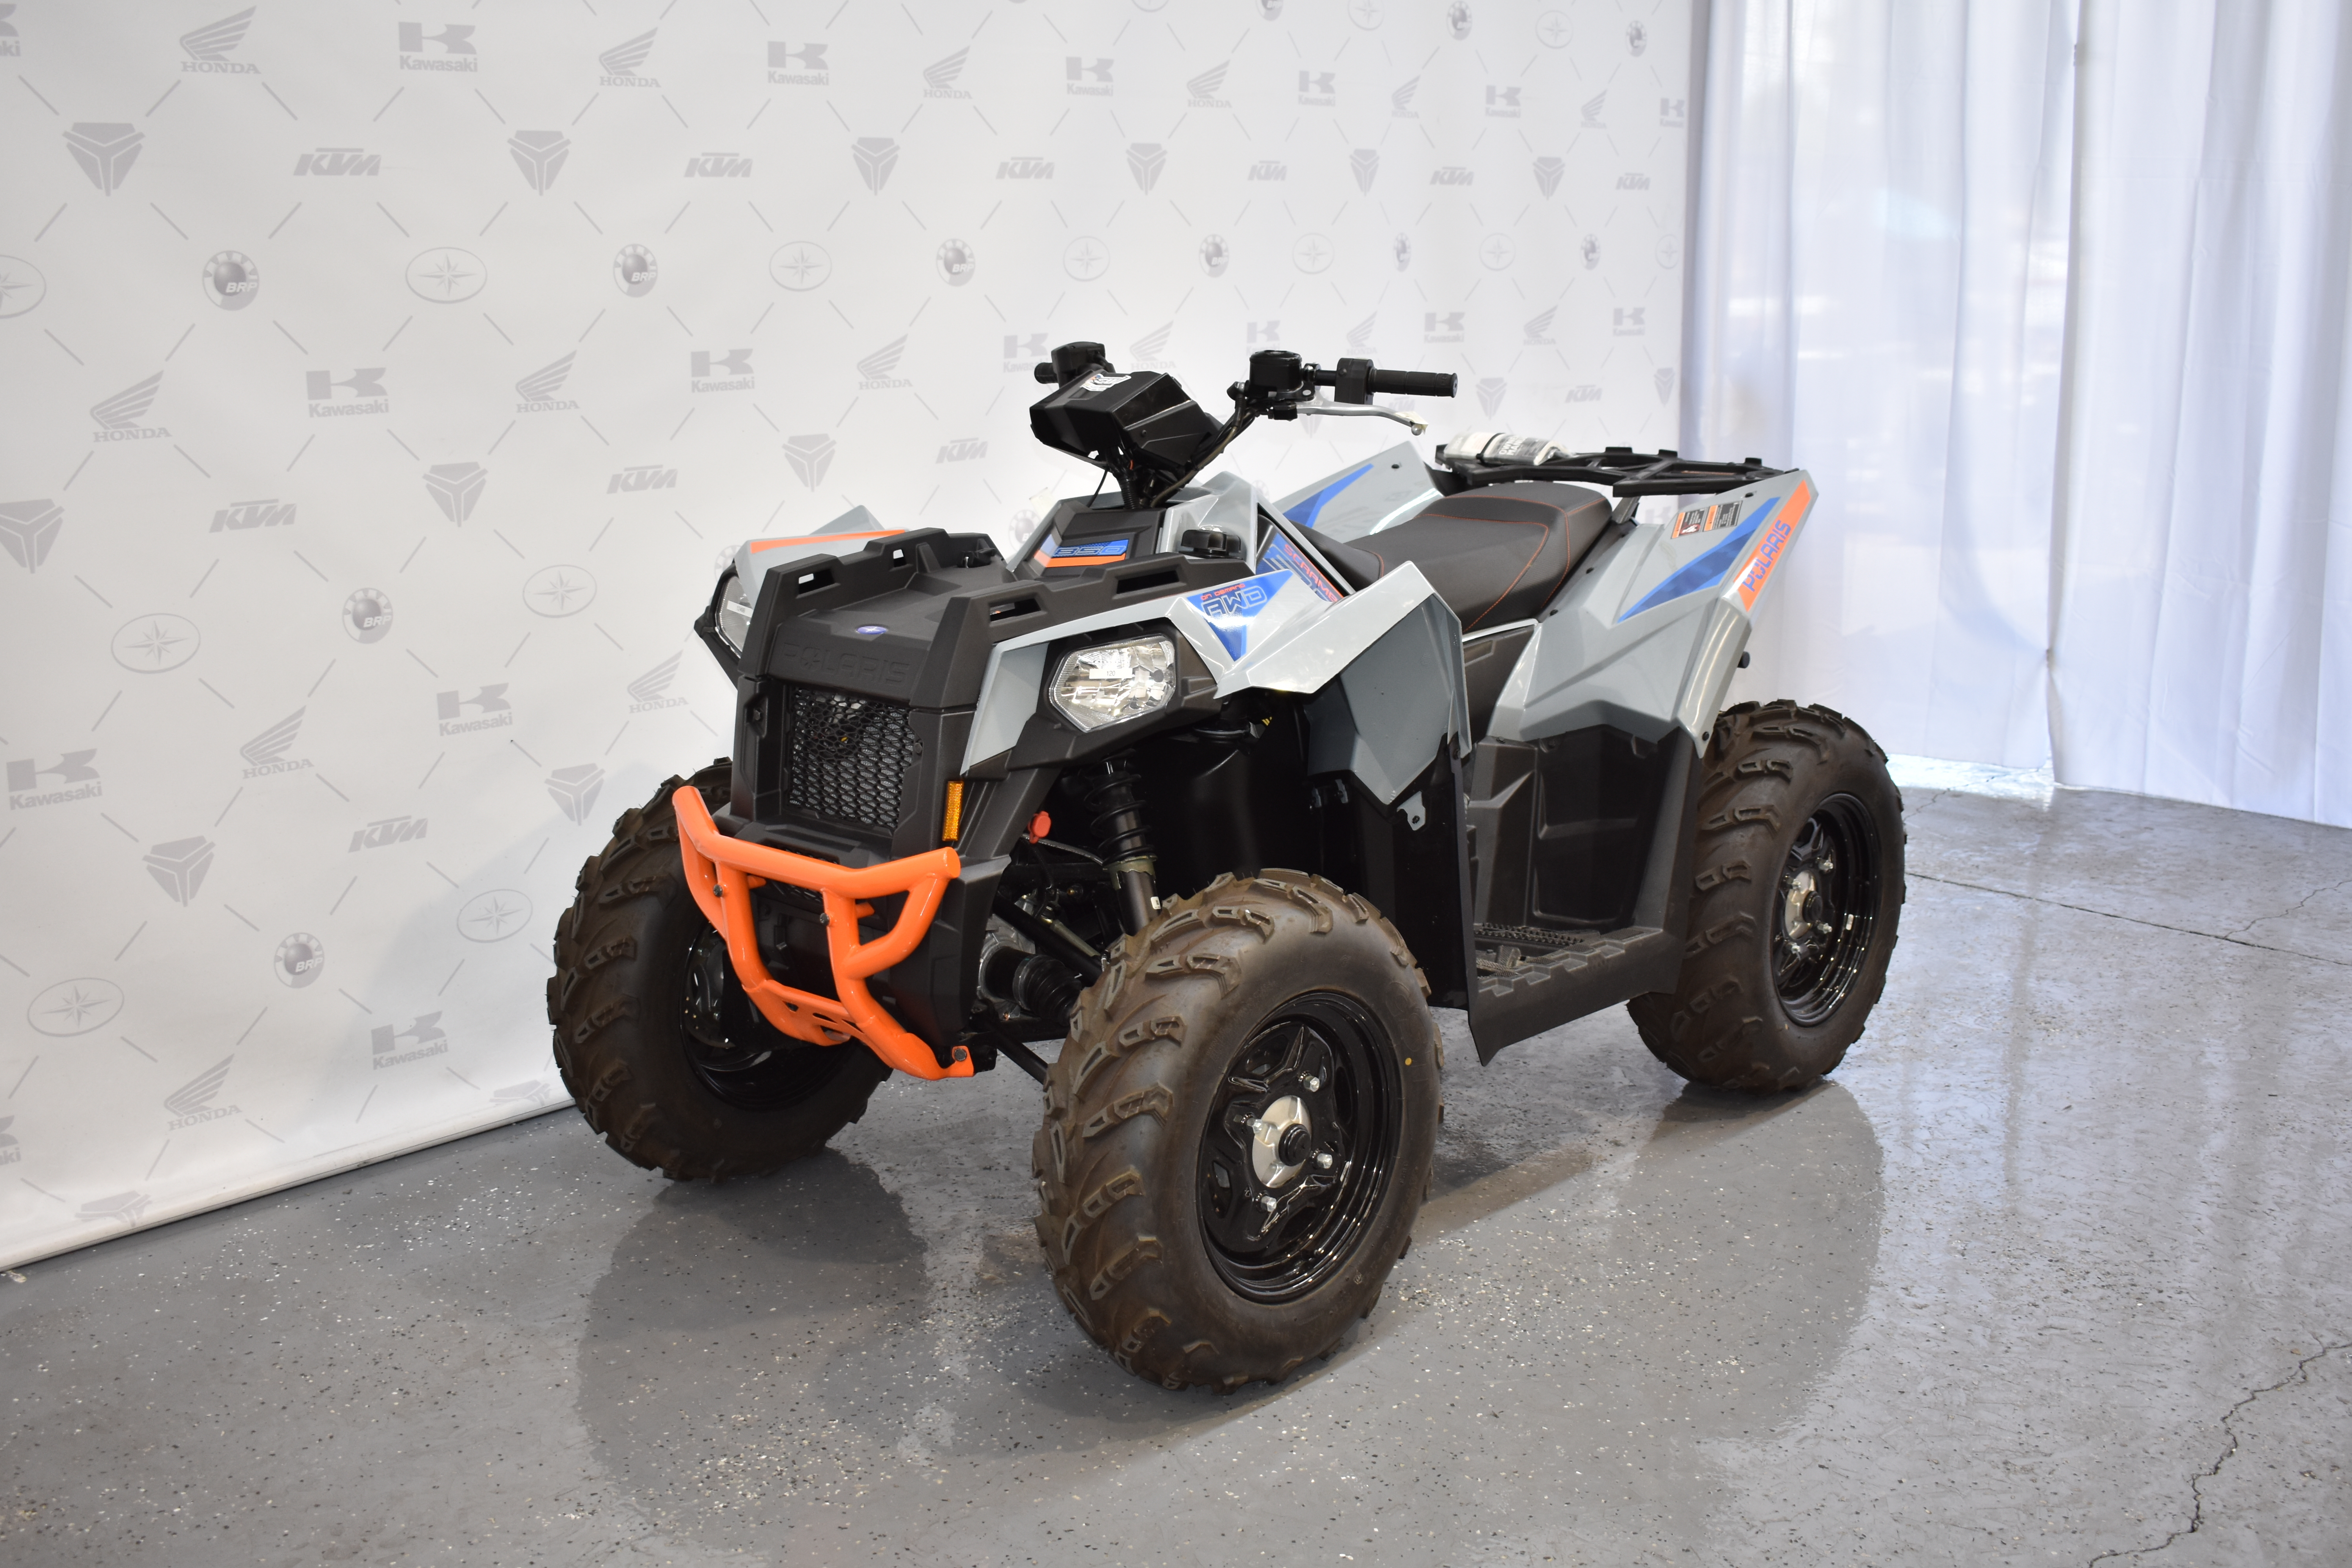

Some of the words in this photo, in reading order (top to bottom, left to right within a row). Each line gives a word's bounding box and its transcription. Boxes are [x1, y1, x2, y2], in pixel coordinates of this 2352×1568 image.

[180, 59, 263, 75] HONDA
[399, 54, 479, 73] Kawasaki
[599, 75, 662, 89] HONDA
[767, 70, 830, 86] Kawasaki
[923, 87, 973, 100] HONDA
[1066, 82, 1114, 97] Kawasaki
[1187, 98, 1233, 109] HONDA
[1297, 94, 1336, 107] Kawasaki
[292, 147, 382, 177] KTM
[683, 152, 753, 178] KTM
[995, 156, 1055, 180] KTM
[1247, 160, 1287, 181] KTM
[1429, 166, 1474, 186] KTM
[1615, 172, 1650, 191] KTM
[952, 263, 974, 272] BRP
[631, 272, 656, 282] BRP
[226, 282, 258, 293] BRP
[1423, 332, 1465, 344] Kawasaki
[1523, 337, 1557, 346] HONDA
[1346, 347, 1378, 356] HONDA
[1131, 361, 1176, 371] HONDA
[690, 376, 755, 394] Kawasaki
[858, 376, 914, 391] HONDA
[1564, 384, 1603, 404] KTM
[307, 397, 390, 419] Kawasaki
[515, 398, 581, 414] HONDA
[92, 425, 173, 443] HONDA
[935, 437, 989, 465] KTM
[606, 464, 678, 495] KTM
[208, 498, 297, 534] KTM
[1054, 545, 1127, 557] 850
[1742, 519, 1791, 592] POLARIS
[1283, 544, 1338, 602] SCRAMB
[1200, 585, 1268, 618] AWD
[364, 615, 392, 628] BRP
[782, 642, 910, 684] POLARIS
[628, 696, 690, 714] HONDA
[438, 712, 514, 737] Kawasaki
[242, 757, 315, 779] HONDA
[9, 781, 103, 811] Kawasaki
[347, 815, 429, 853] KTM
[295, 957, 324, 972] BRP
[371, 1040, 450, 1071] Kawasaki
[167, 1103, 243, 1131] HONDA
